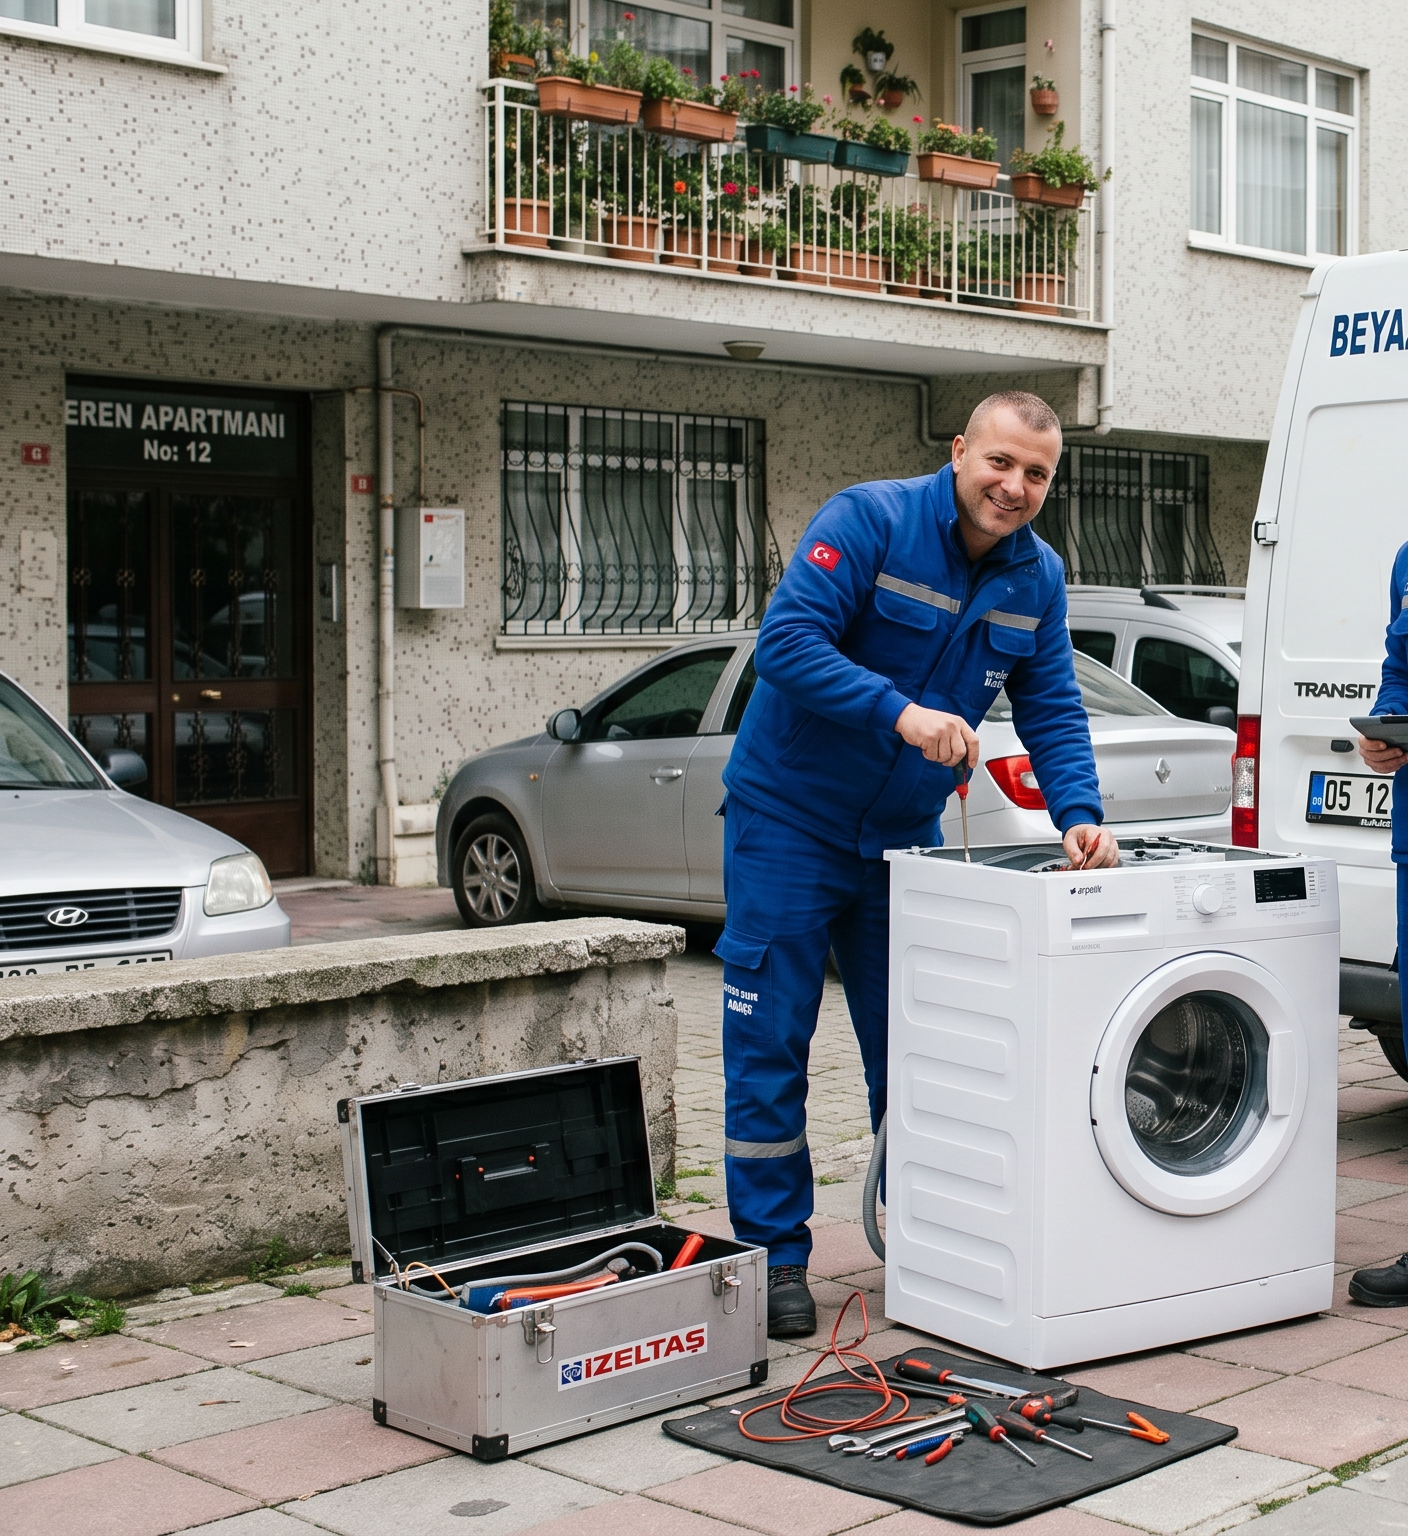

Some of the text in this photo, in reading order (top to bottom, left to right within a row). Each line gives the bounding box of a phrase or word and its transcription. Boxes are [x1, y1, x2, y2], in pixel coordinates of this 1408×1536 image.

[65, 399, 285, 438] EREN APARTMANI
[143, 438, 212, 463] No: 12
[1293, 681, 1376, 699] TRANSIT
[1324, 779, 1390, 815] 05 12
